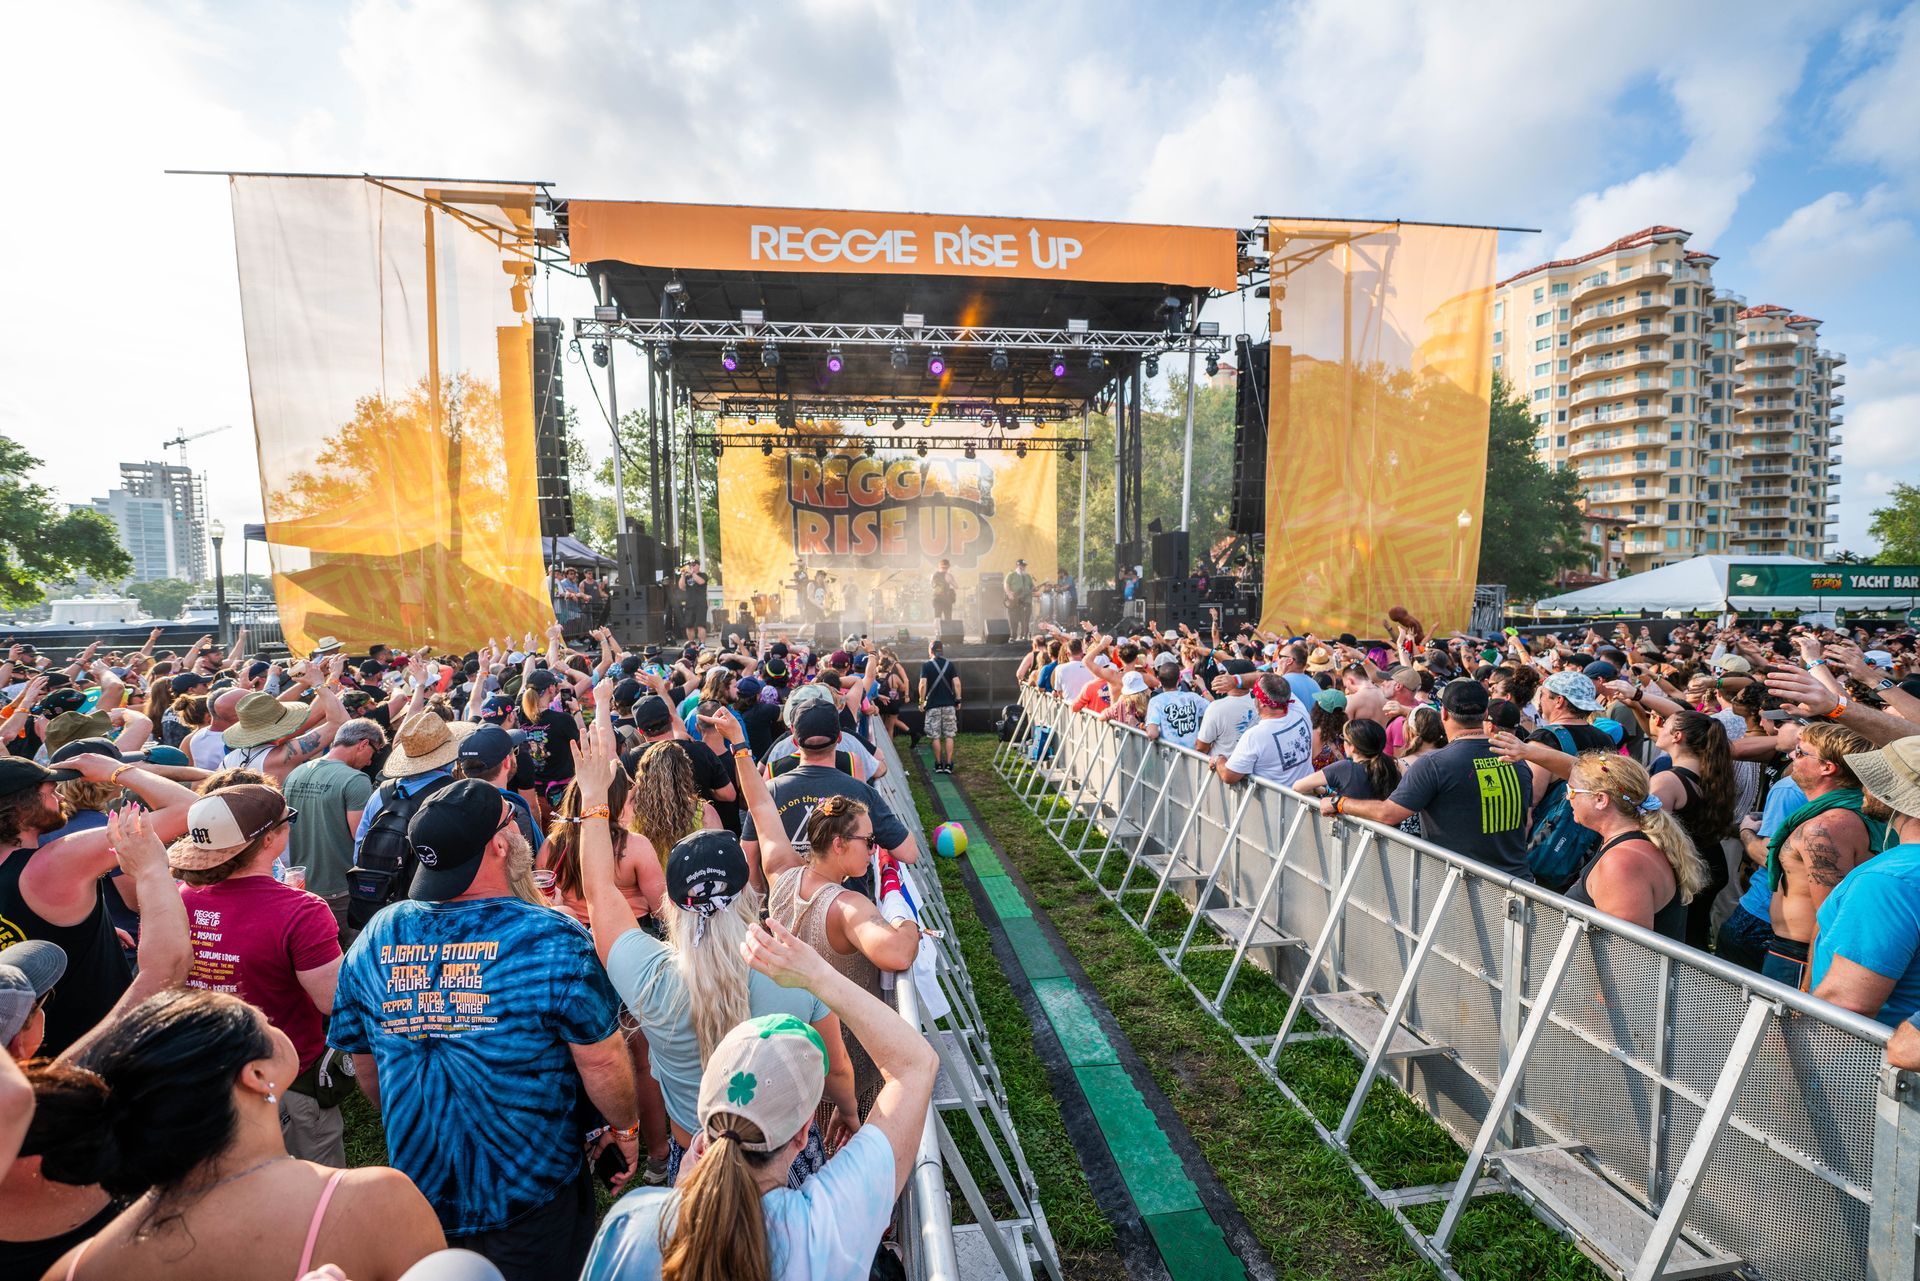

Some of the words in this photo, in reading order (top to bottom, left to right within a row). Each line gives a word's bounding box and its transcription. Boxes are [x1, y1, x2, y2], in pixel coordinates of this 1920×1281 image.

[751, 224, 917, 264] REGGAE
[934, 223, 1018, 267] RISE
[1028, 227, 1083, 270] UP
[790, 454, 983, 508] REGGAE
[797, 508, 908, 556] RISE
[919, 506, 981, 556] UP
[1850, 576, 1890, 588] YACHT
[1894, 576, 1919, 588] BAR
[1164, 701, 1196, 722] Bowl
[1172, 718, 1196, 736] Two
[1473, 757, 1512, 769] FREEDO
[788, 798, 800, 807] on
[802, 795, 818, 803] the
[194, 910, 221, 920] REGGAE
[196, 918, 210, 926] RISE
[211, 918, 220, 928] UP
[197, 932, 222, 941] DISPATCH
[380, 945, 438, 964] SLIGHTLY
[442, 942, 499, 960] STOOPID
[391, 965, 427, 979] STICK
[442, 963, 481, 977] DIRTY
[387, 977, 431, 993] FIGURE
[440, 975, 483, 989] HEADS
[418, 992, 445, 1003] STEEL
[449, 992, 490, 1004] COMMON
[382, 999, 412, 1013] PEPPER
[418, 1003, 445, 1013] PULSE
[456, 1003, 483, 1014] KINGS
